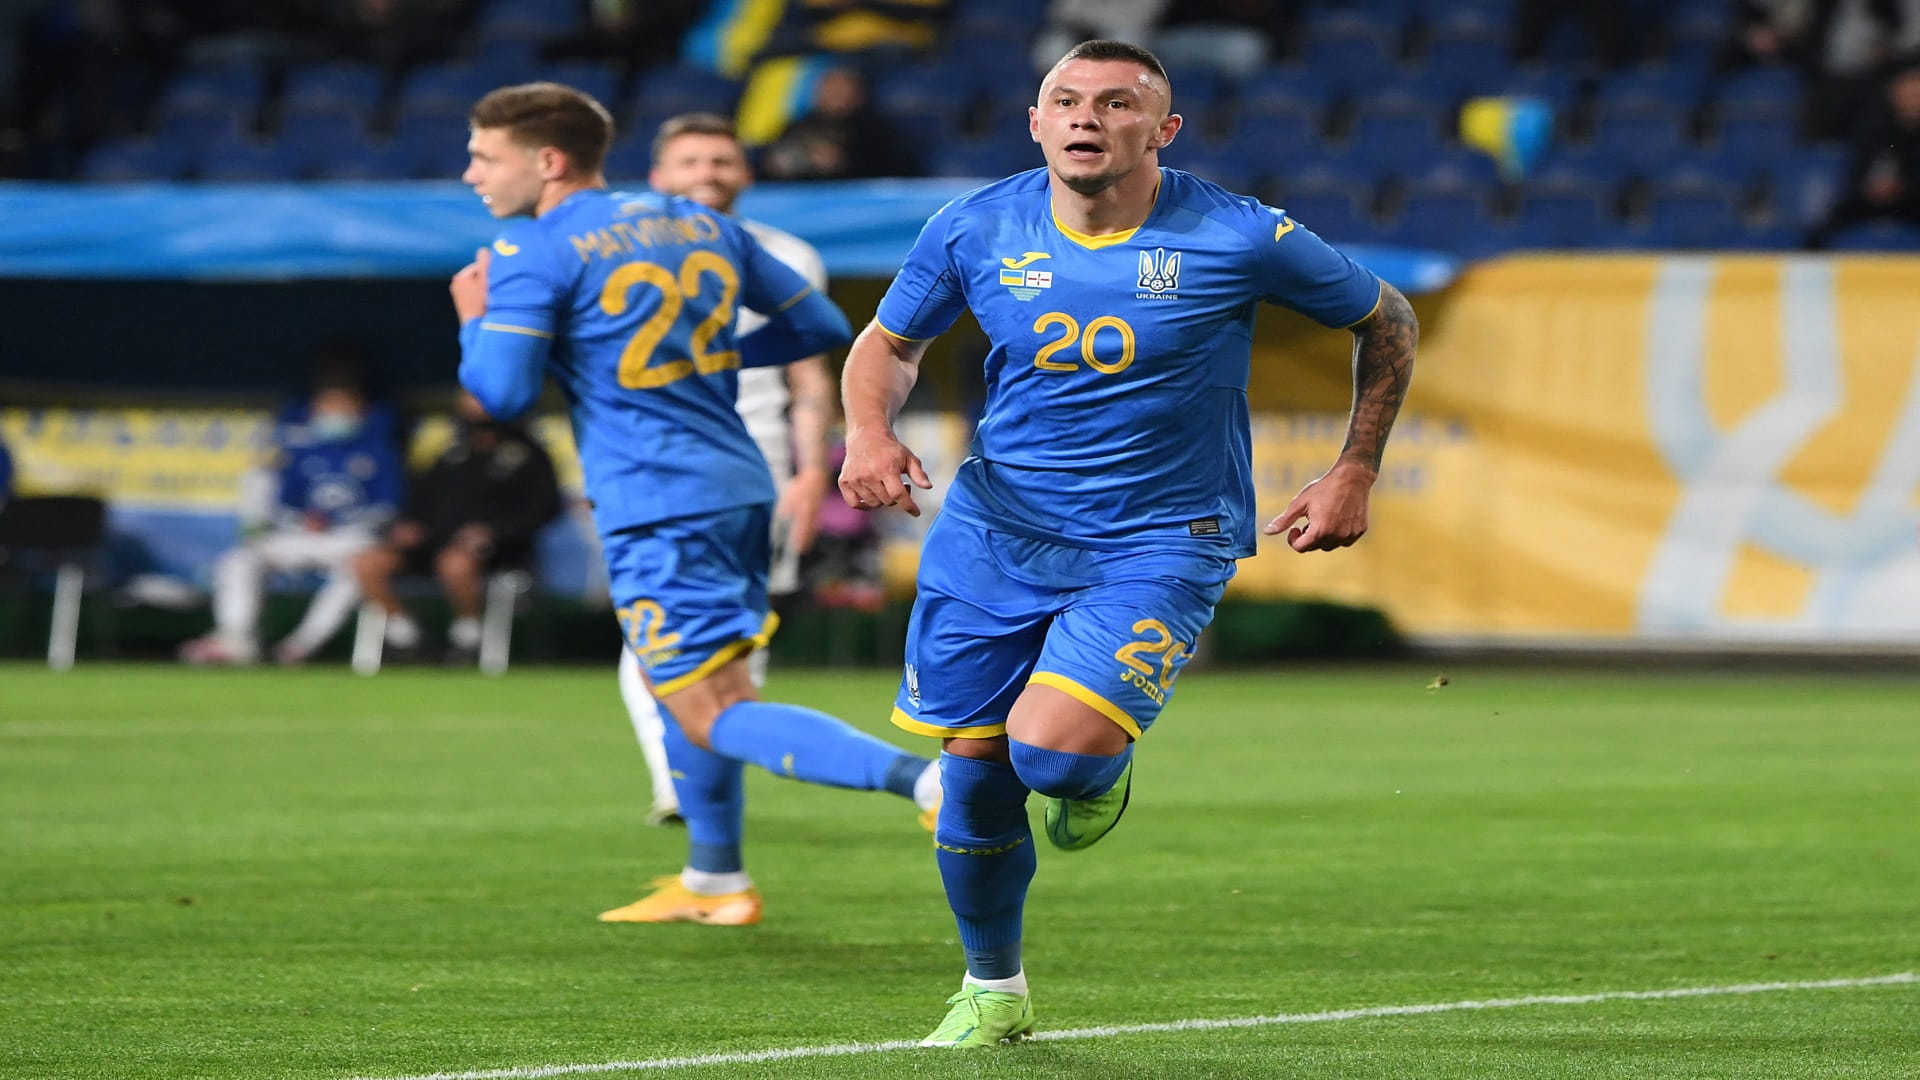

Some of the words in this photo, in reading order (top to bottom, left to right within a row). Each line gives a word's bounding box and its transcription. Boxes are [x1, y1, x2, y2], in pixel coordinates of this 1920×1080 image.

[601, 250, 741, 390] 22
[1136, 292, 1178, 301] UKRAINE
[1033, 311, 1136, 374] 20
[615, 599, 682, 656] 22
